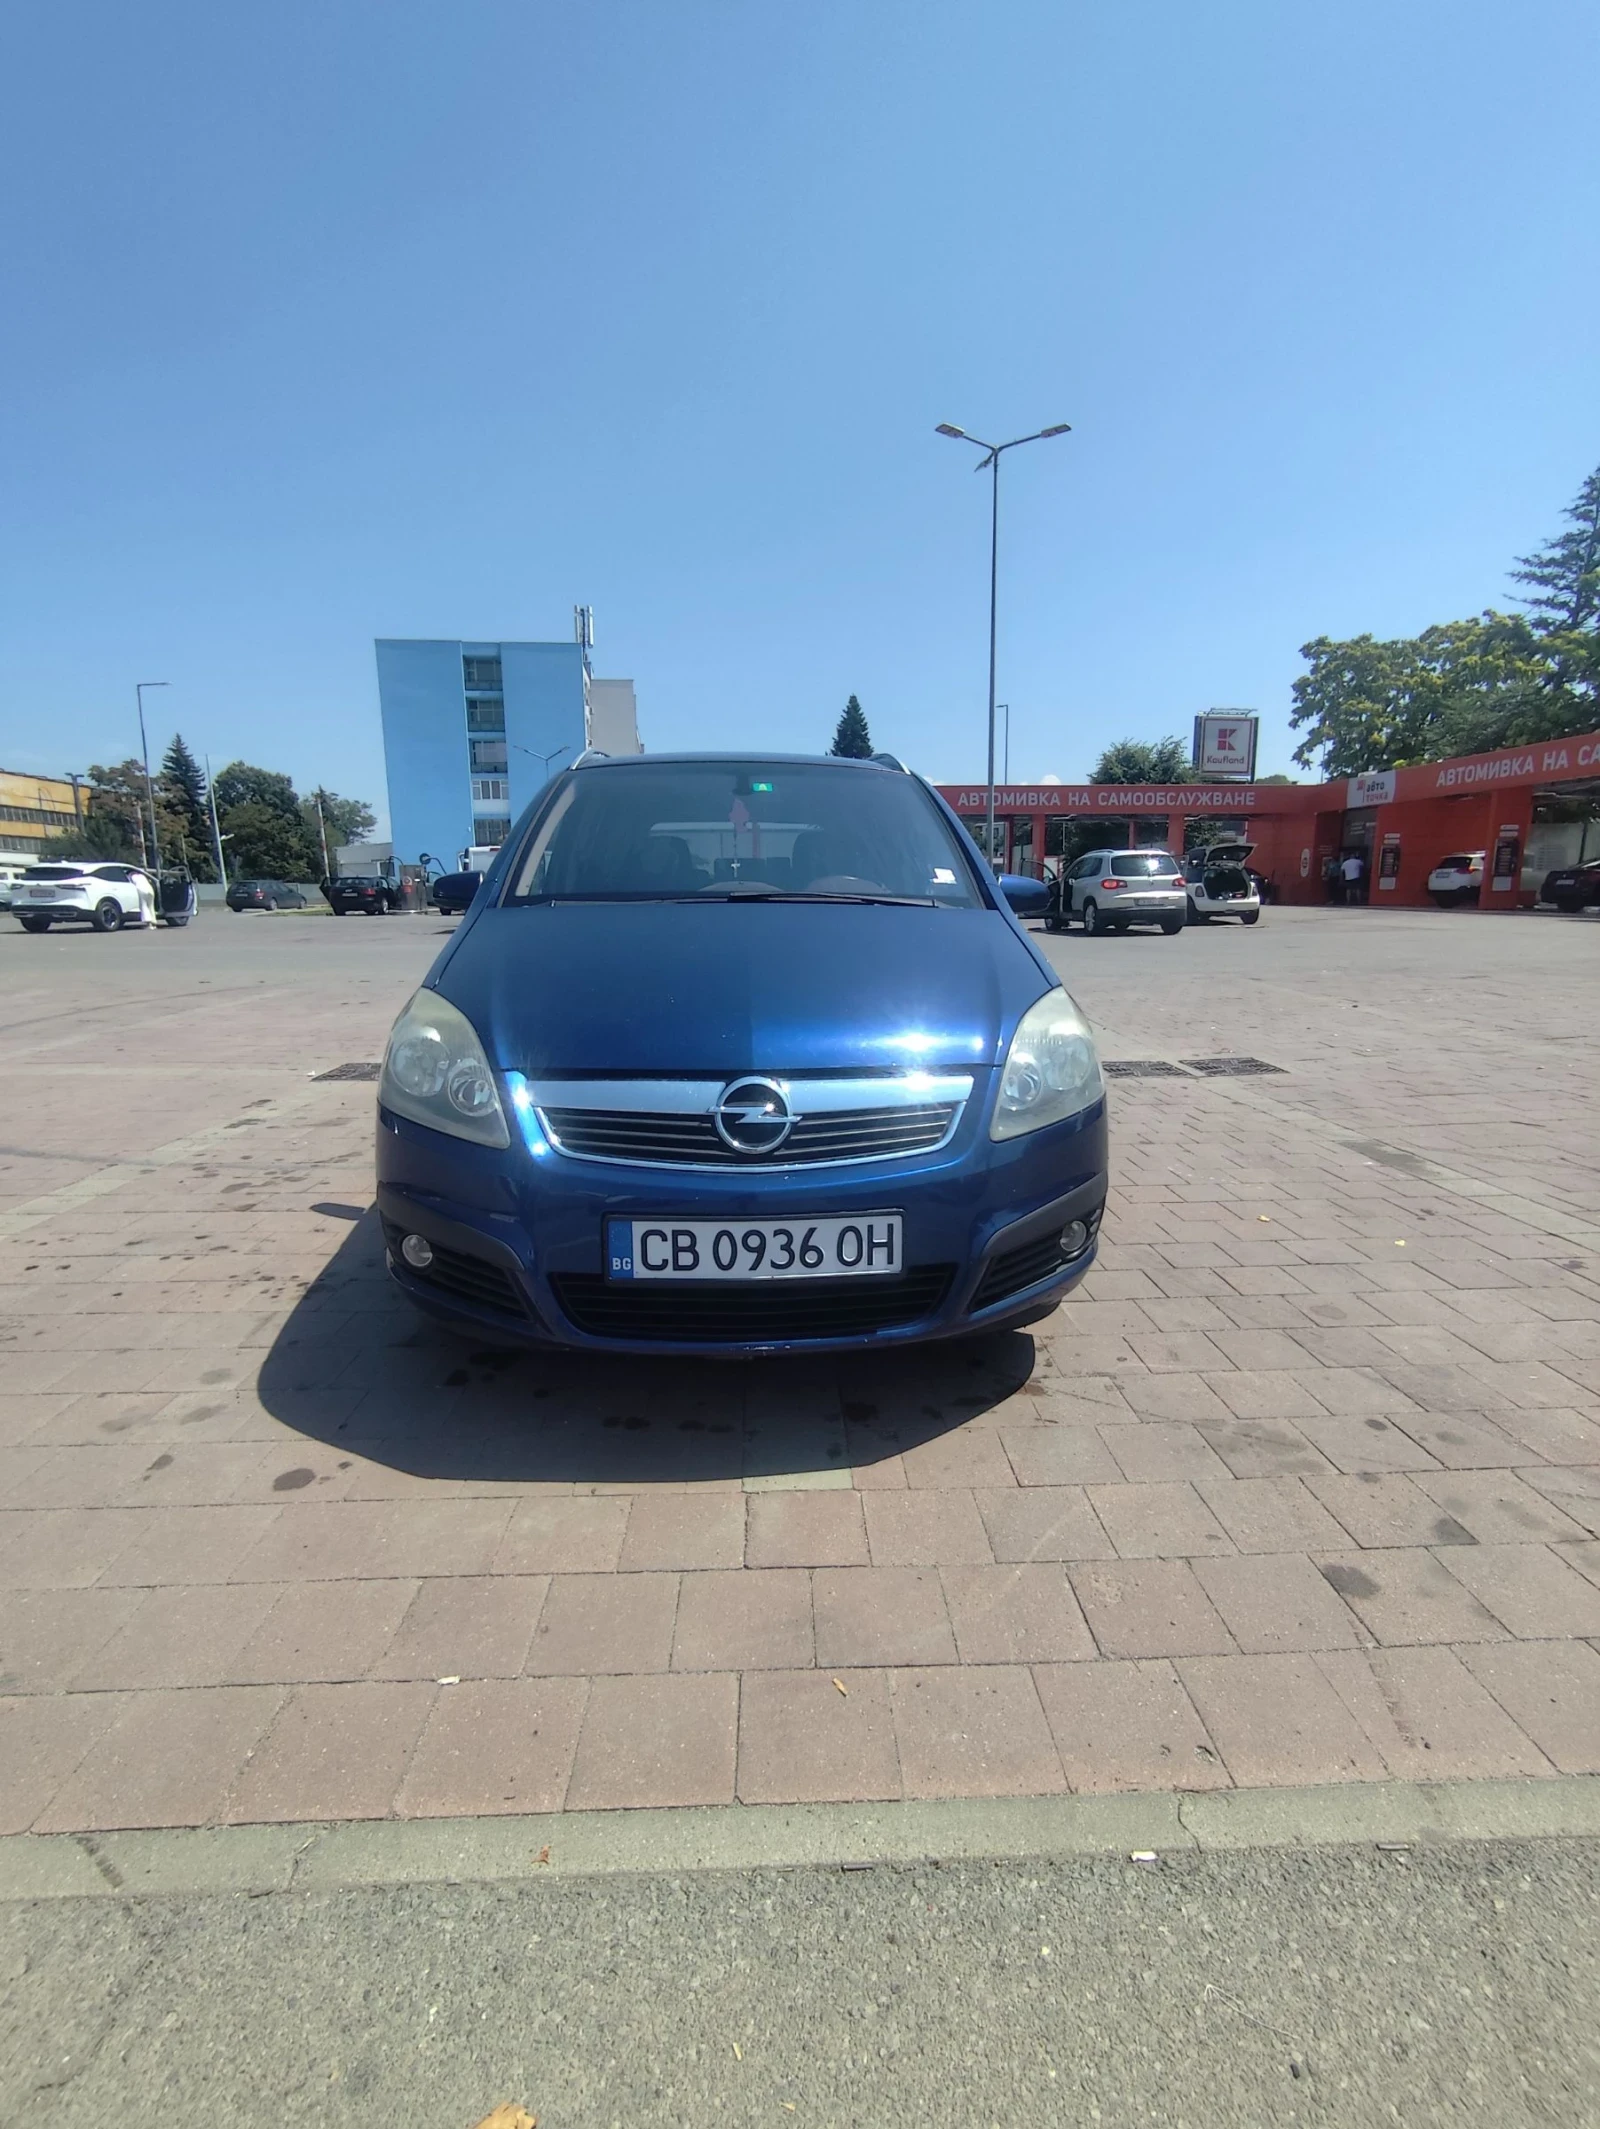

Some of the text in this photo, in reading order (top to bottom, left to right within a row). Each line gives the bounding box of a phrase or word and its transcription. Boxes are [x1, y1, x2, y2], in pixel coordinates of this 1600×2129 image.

[1206, 755, 1245, 764] Kaufland
[1436, 756, 1534, 787] АВТОМИВКА
[1542, 749, 1569, 772] НА
[957, 791, 1256, 807] АВТОМИВКА НА САМООБСЛУЖВАНЕ
[712, 1227, 825, 1271] 0936
[612, 1257, 632, 1271] BG
